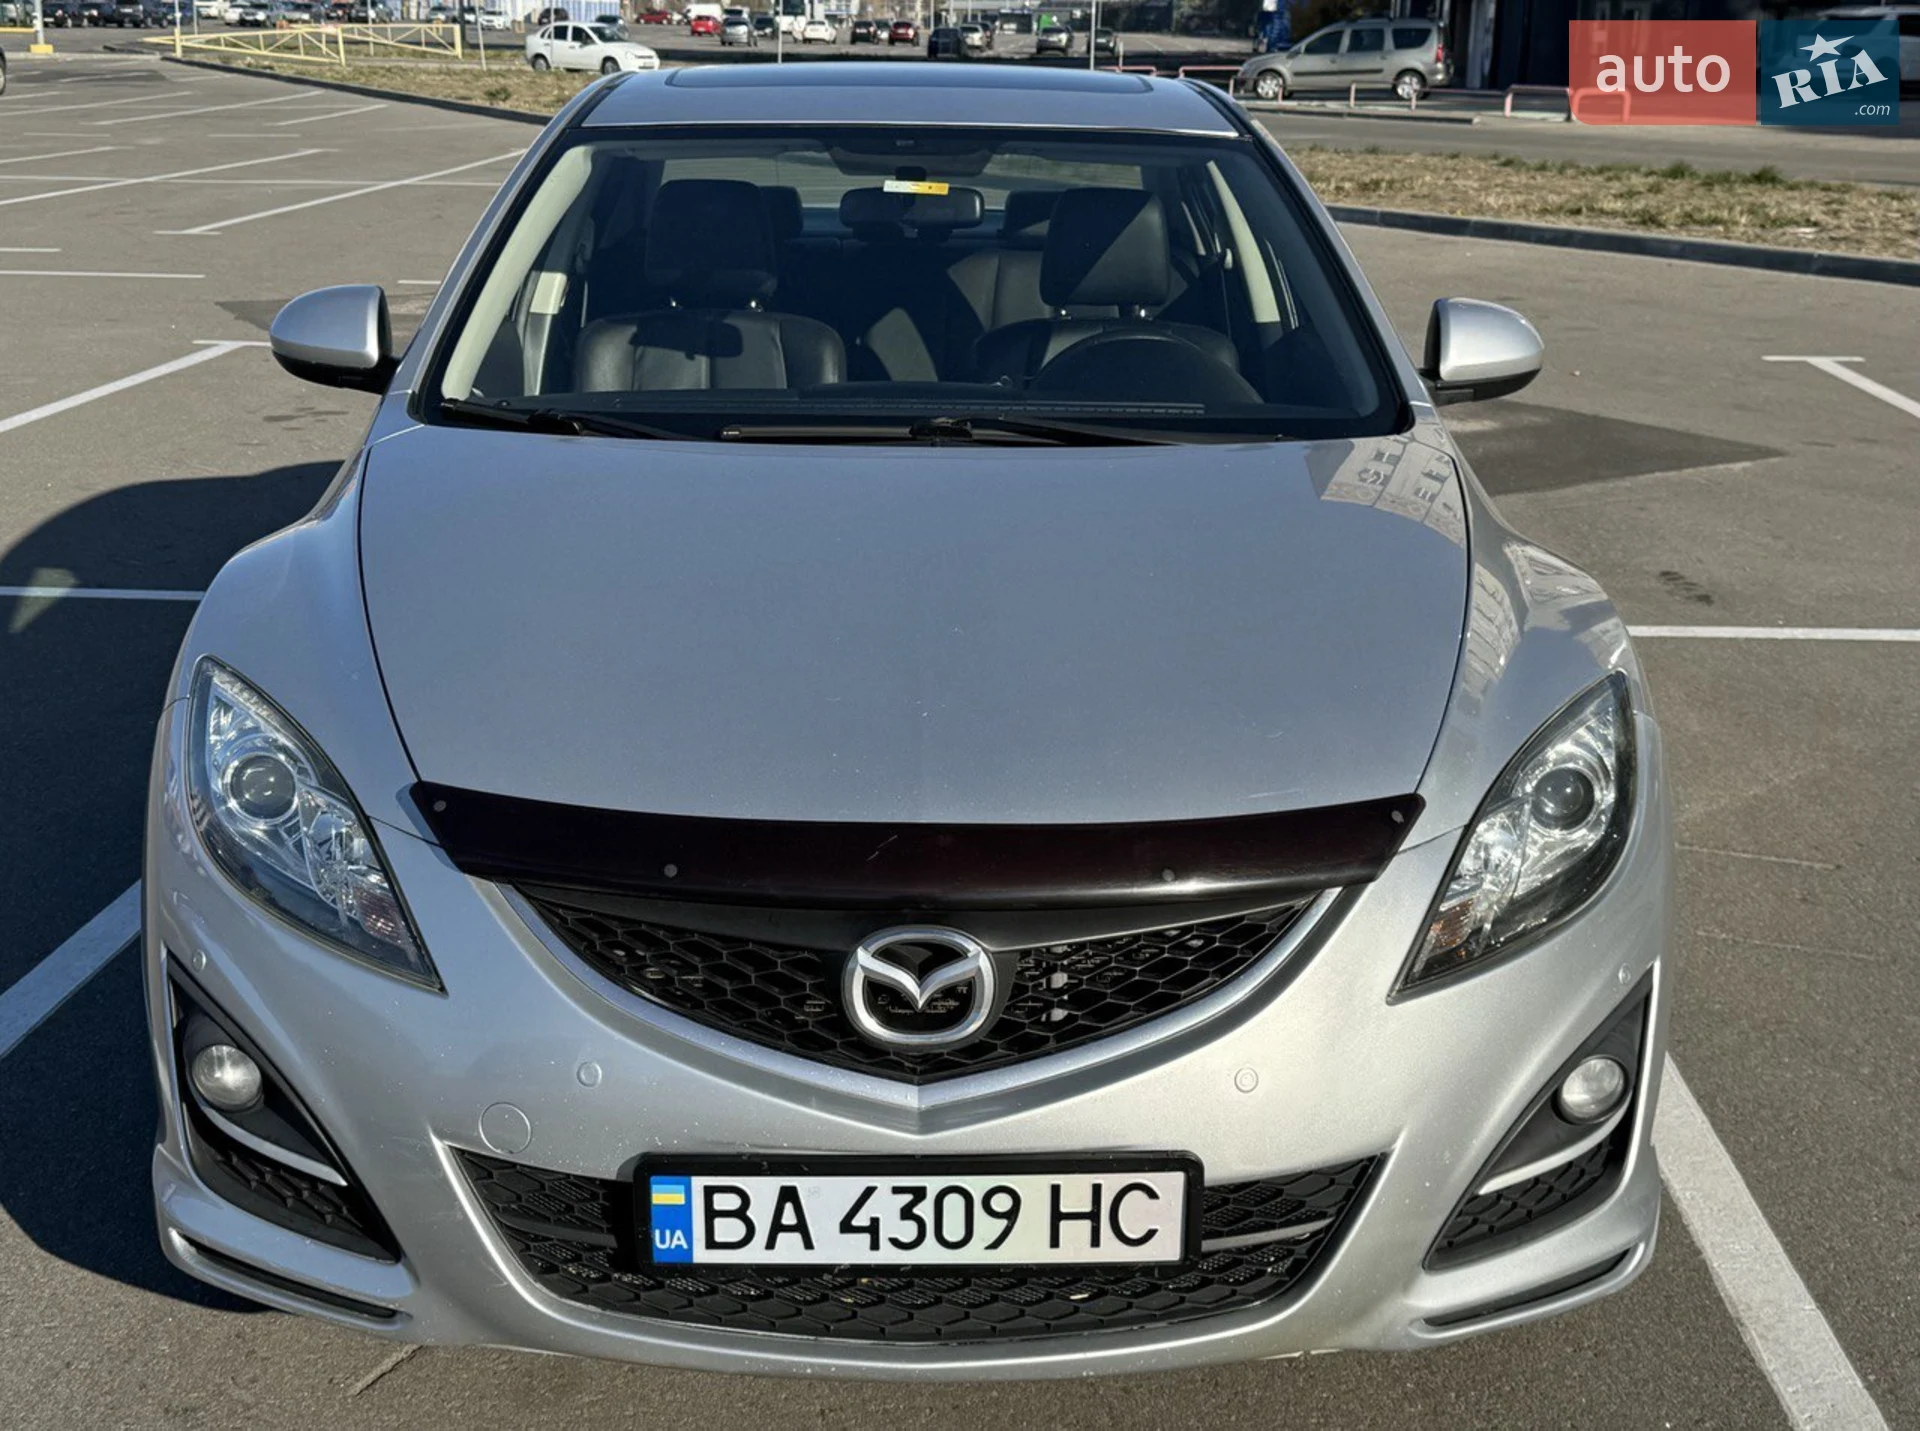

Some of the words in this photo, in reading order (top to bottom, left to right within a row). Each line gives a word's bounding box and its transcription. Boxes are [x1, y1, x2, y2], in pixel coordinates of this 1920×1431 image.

[654, 1228, 688, 1250] UA
[702, 1184, 815, 1251] BA
[839, 1184, 1022, 1251] 4309
[1050, 1183, 1160, 1249] HC
